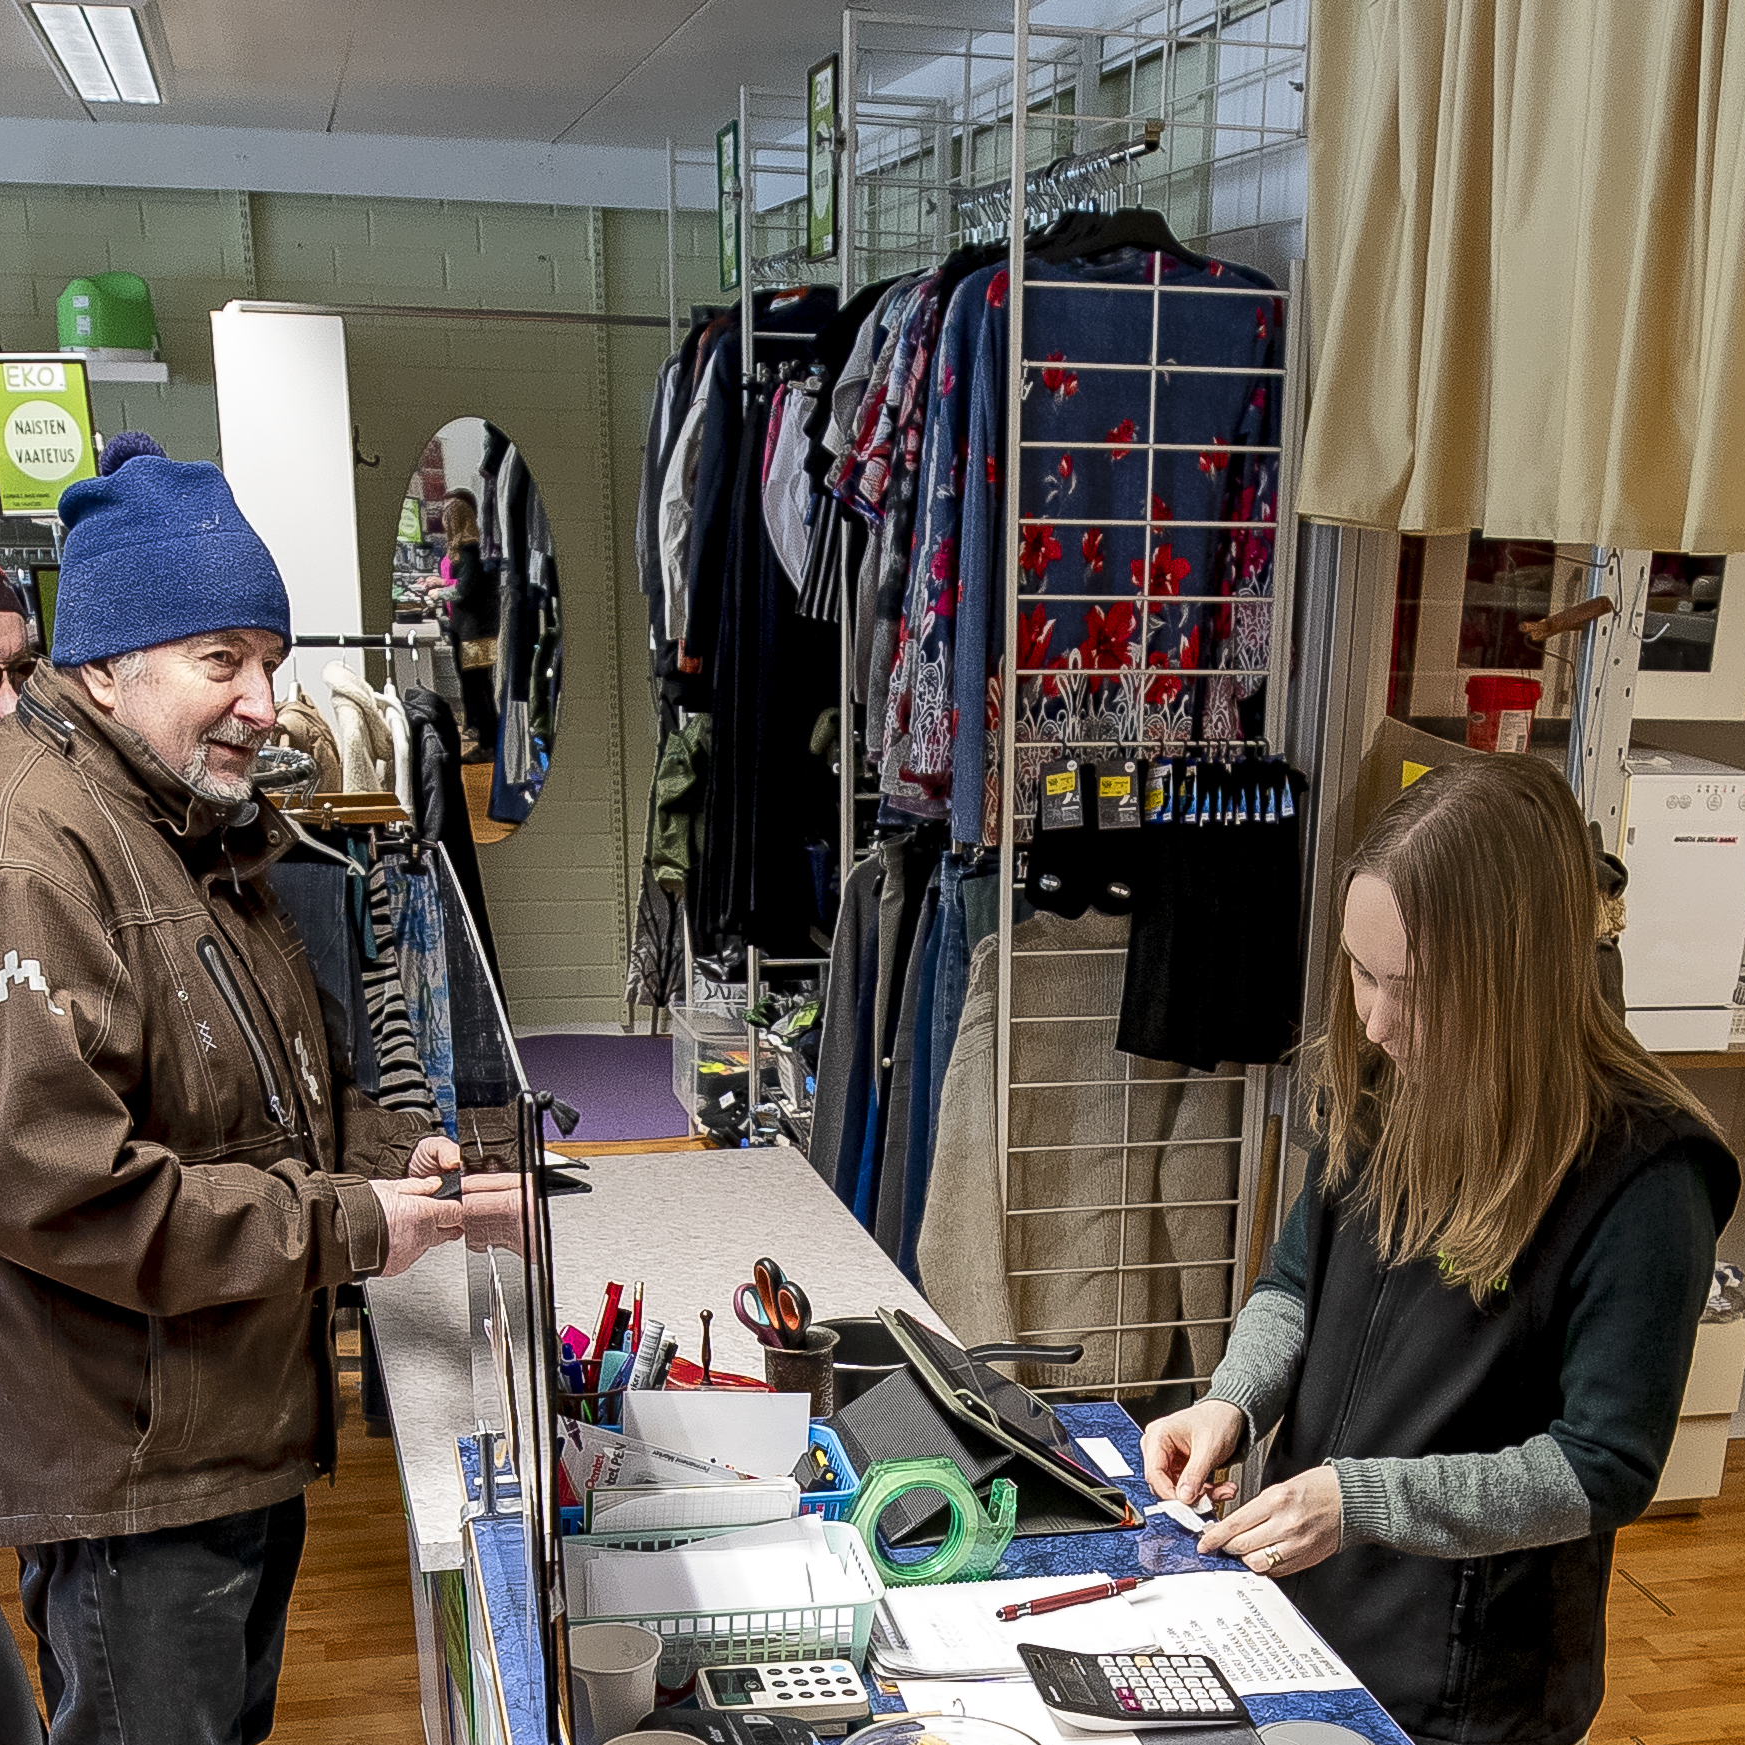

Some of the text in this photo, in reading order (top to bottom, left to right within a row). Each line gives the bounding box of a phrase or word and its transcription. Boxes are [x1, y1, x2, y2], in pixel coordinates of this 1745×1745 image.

[14, 419, 66, 435] NAISTEN
[15, 448, 75, 464] VAATETUS
[611, 1442, 627, 1468] PEN
[585, 1453, 606, 1490] Pentel
